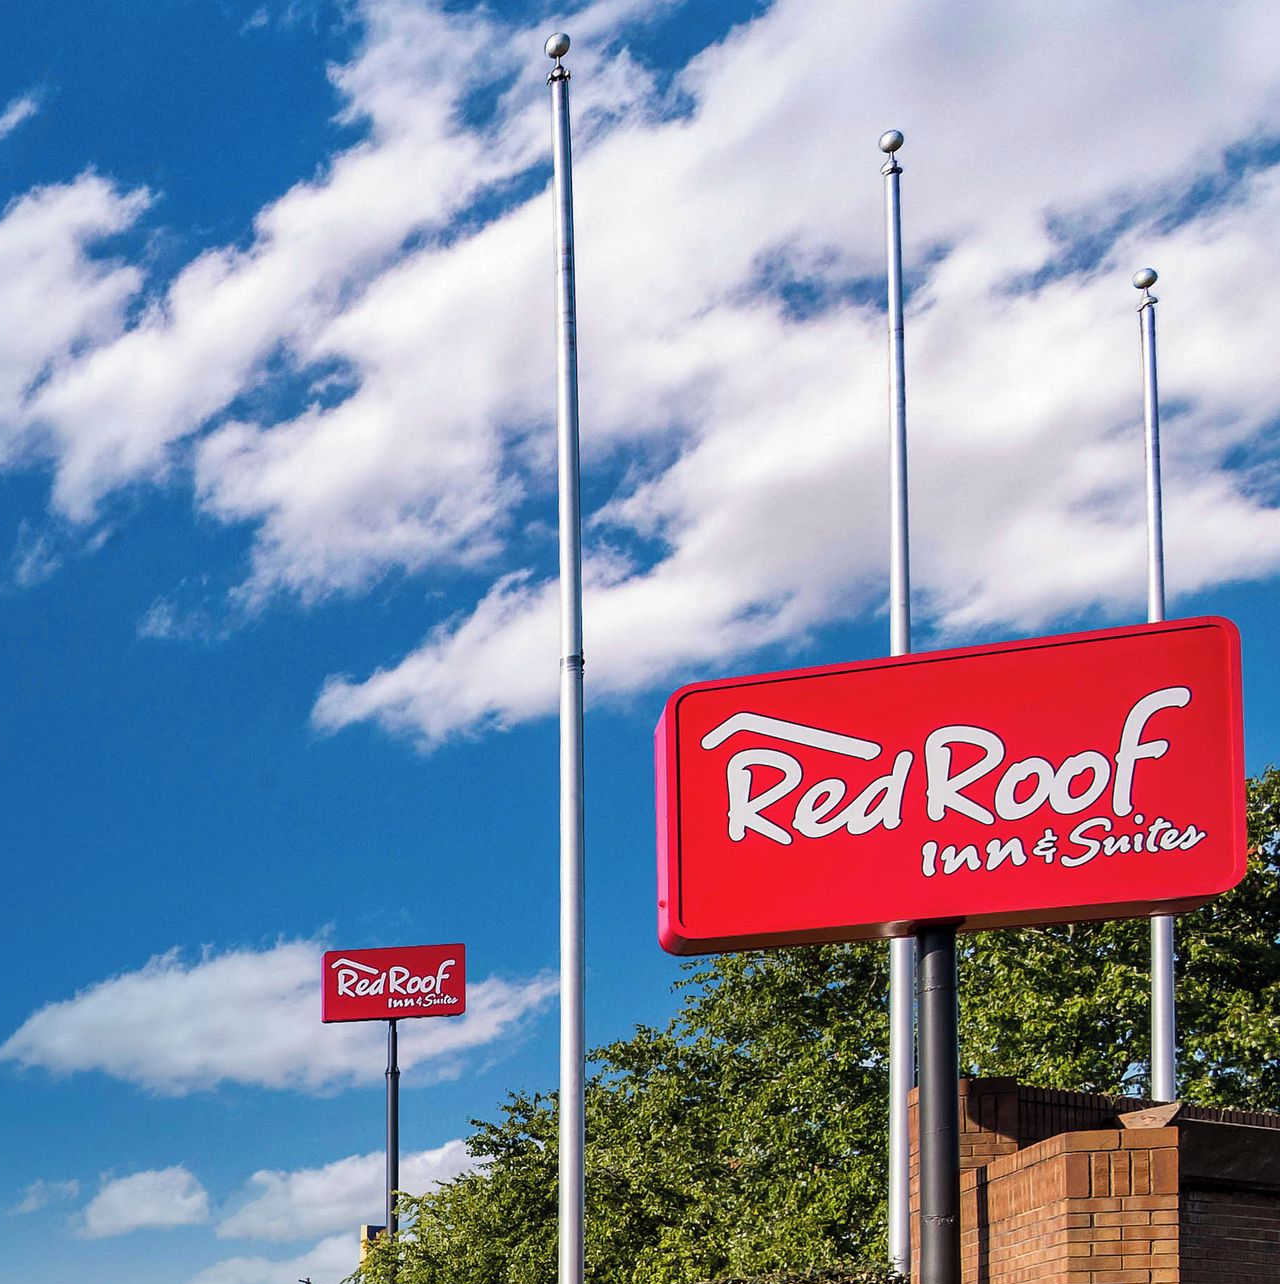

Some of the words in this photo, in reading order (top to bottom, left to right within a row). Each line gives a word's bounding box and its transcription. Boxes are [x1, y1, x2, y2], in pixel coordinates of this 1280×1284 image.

[726, 747, 914, 846] Red
[923, 685, 1192, 825] Roof
[921, 837, 1028, 877] Inn
[1032, 827, 1059, 864] &
[1060, 814, 1207, 868] Suites
[337, 968, 387, 998] Red
[389, 959, 456, 995] Roof
[387, 997, 415, 1009] Inn
[416, 996, 422, 1007] &
[422, 993, 459, 1008] Suites
